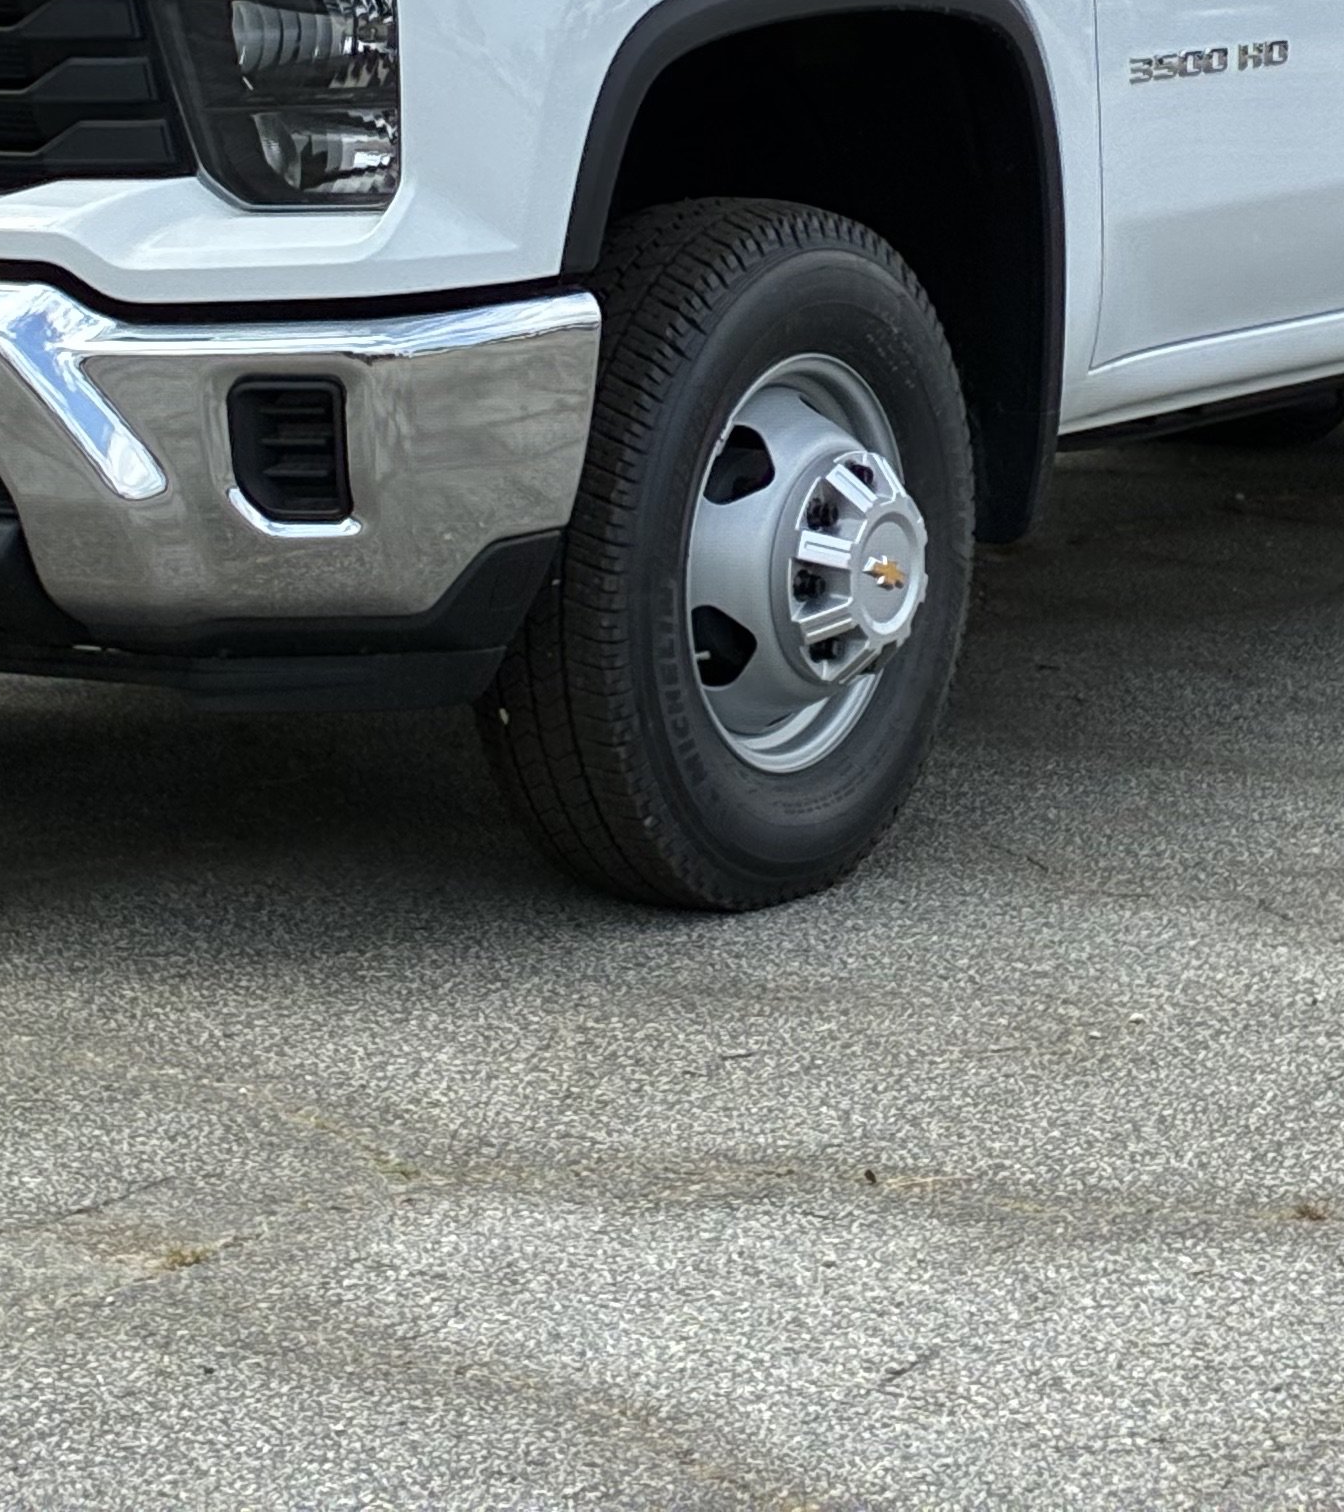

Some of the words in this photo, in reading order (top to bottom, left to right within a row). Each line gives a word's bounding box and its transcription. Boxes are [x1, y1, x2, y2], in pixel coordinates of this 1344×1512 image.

[1129, 47, 1229, 85] 3500
[1238, 39, 1290, 72] HD
[654, 579, 706, 787] MICHELIN
